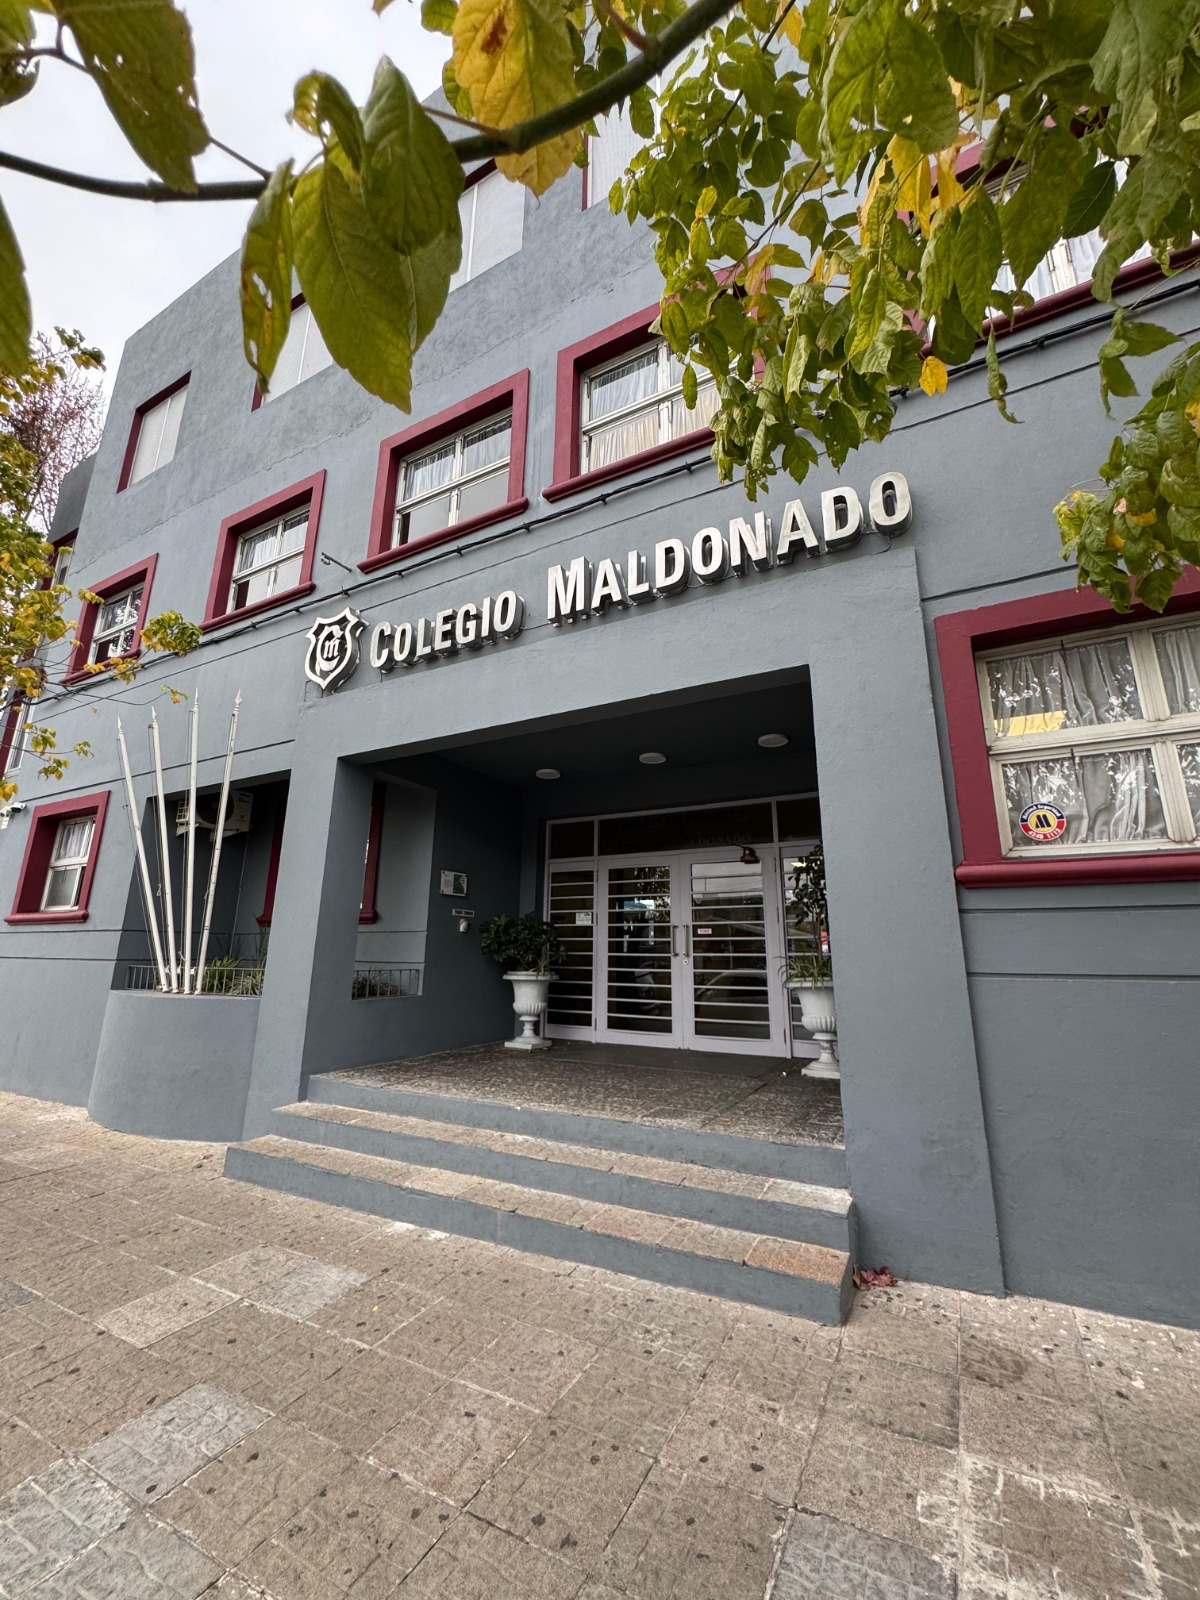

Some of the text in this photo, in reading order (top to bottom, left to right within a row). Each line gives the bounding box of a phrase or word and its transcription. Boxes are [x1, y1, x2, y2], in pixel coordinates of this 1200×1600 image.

[370, 471, 912, 671] COLEGIO MALDONADO
[683, 834, 751, 848] ALDONADO
